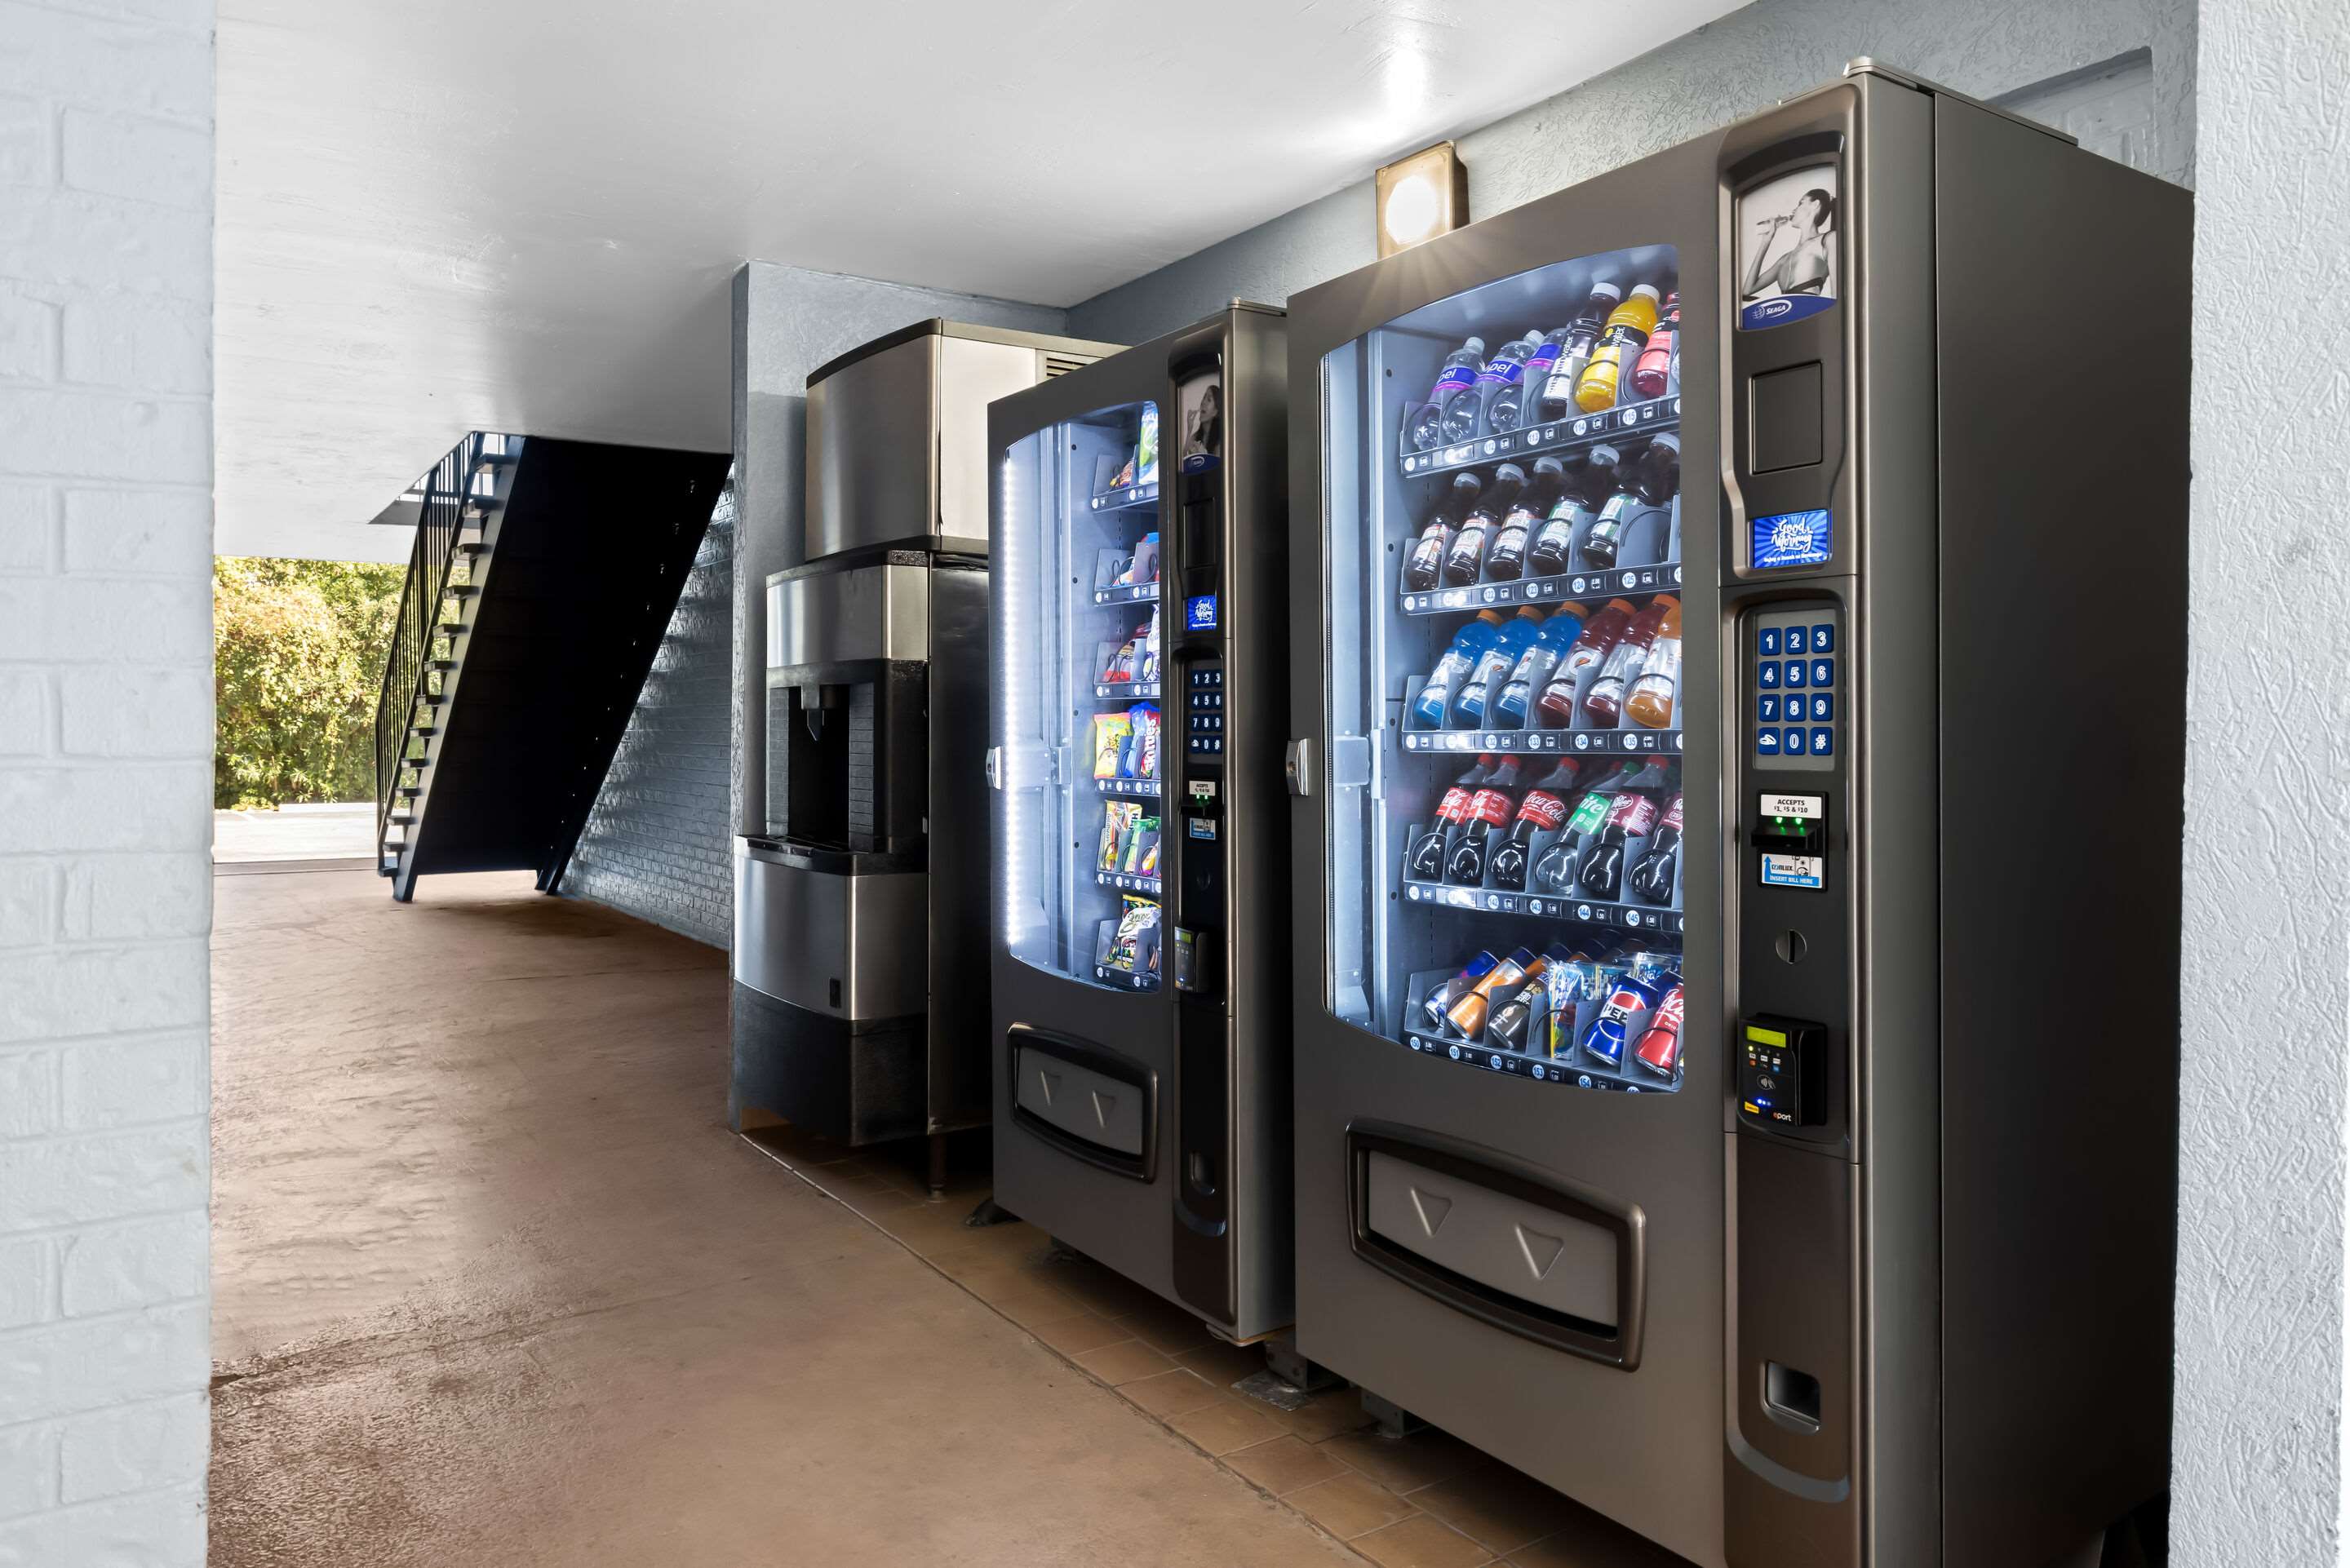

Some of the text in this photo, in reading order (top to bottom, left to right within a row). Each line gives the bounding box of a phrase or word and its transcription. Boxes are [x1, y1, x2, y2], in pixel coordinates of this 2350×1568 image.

[1766, 305, 1786, 315] SEAGA
[1779, 517, 1807, 536] Good
[1771, 534, 1812, 552] Morning
[1766, 634, 1773, 649] 1
[1789, 633, 1800, 649] 2
[1816, 631, 1827, 647] 3
[1194, 673, 1199, 684] 1
[1204, 673, 1209, 684] 2
[1215, 672, 1221, 684] 3
[1763, 667, 1774, 683] 4
[1789, 667, 1800, 682] 5
[1816, 665, 1826, 681] 6
[1193, 695, 1199, 706] 4
[1204, 695, 1209, 706] 5
[1816, 700, 1826, 715] 9
[1763, 701, 1773, 715] 7
[1789, 700, 1799, 716] 8
[1193, 717, 1198, 728] 7
[1204, 717, 1209, 728] 8
[1215, 717, 1221, 728] 9
[1204, 739, 1208, 750] 0
[1789, 733, 1799, 749] 0
[1815, 734, 1826, 750] #
[1773, 1111, 1792, 1122] eport
